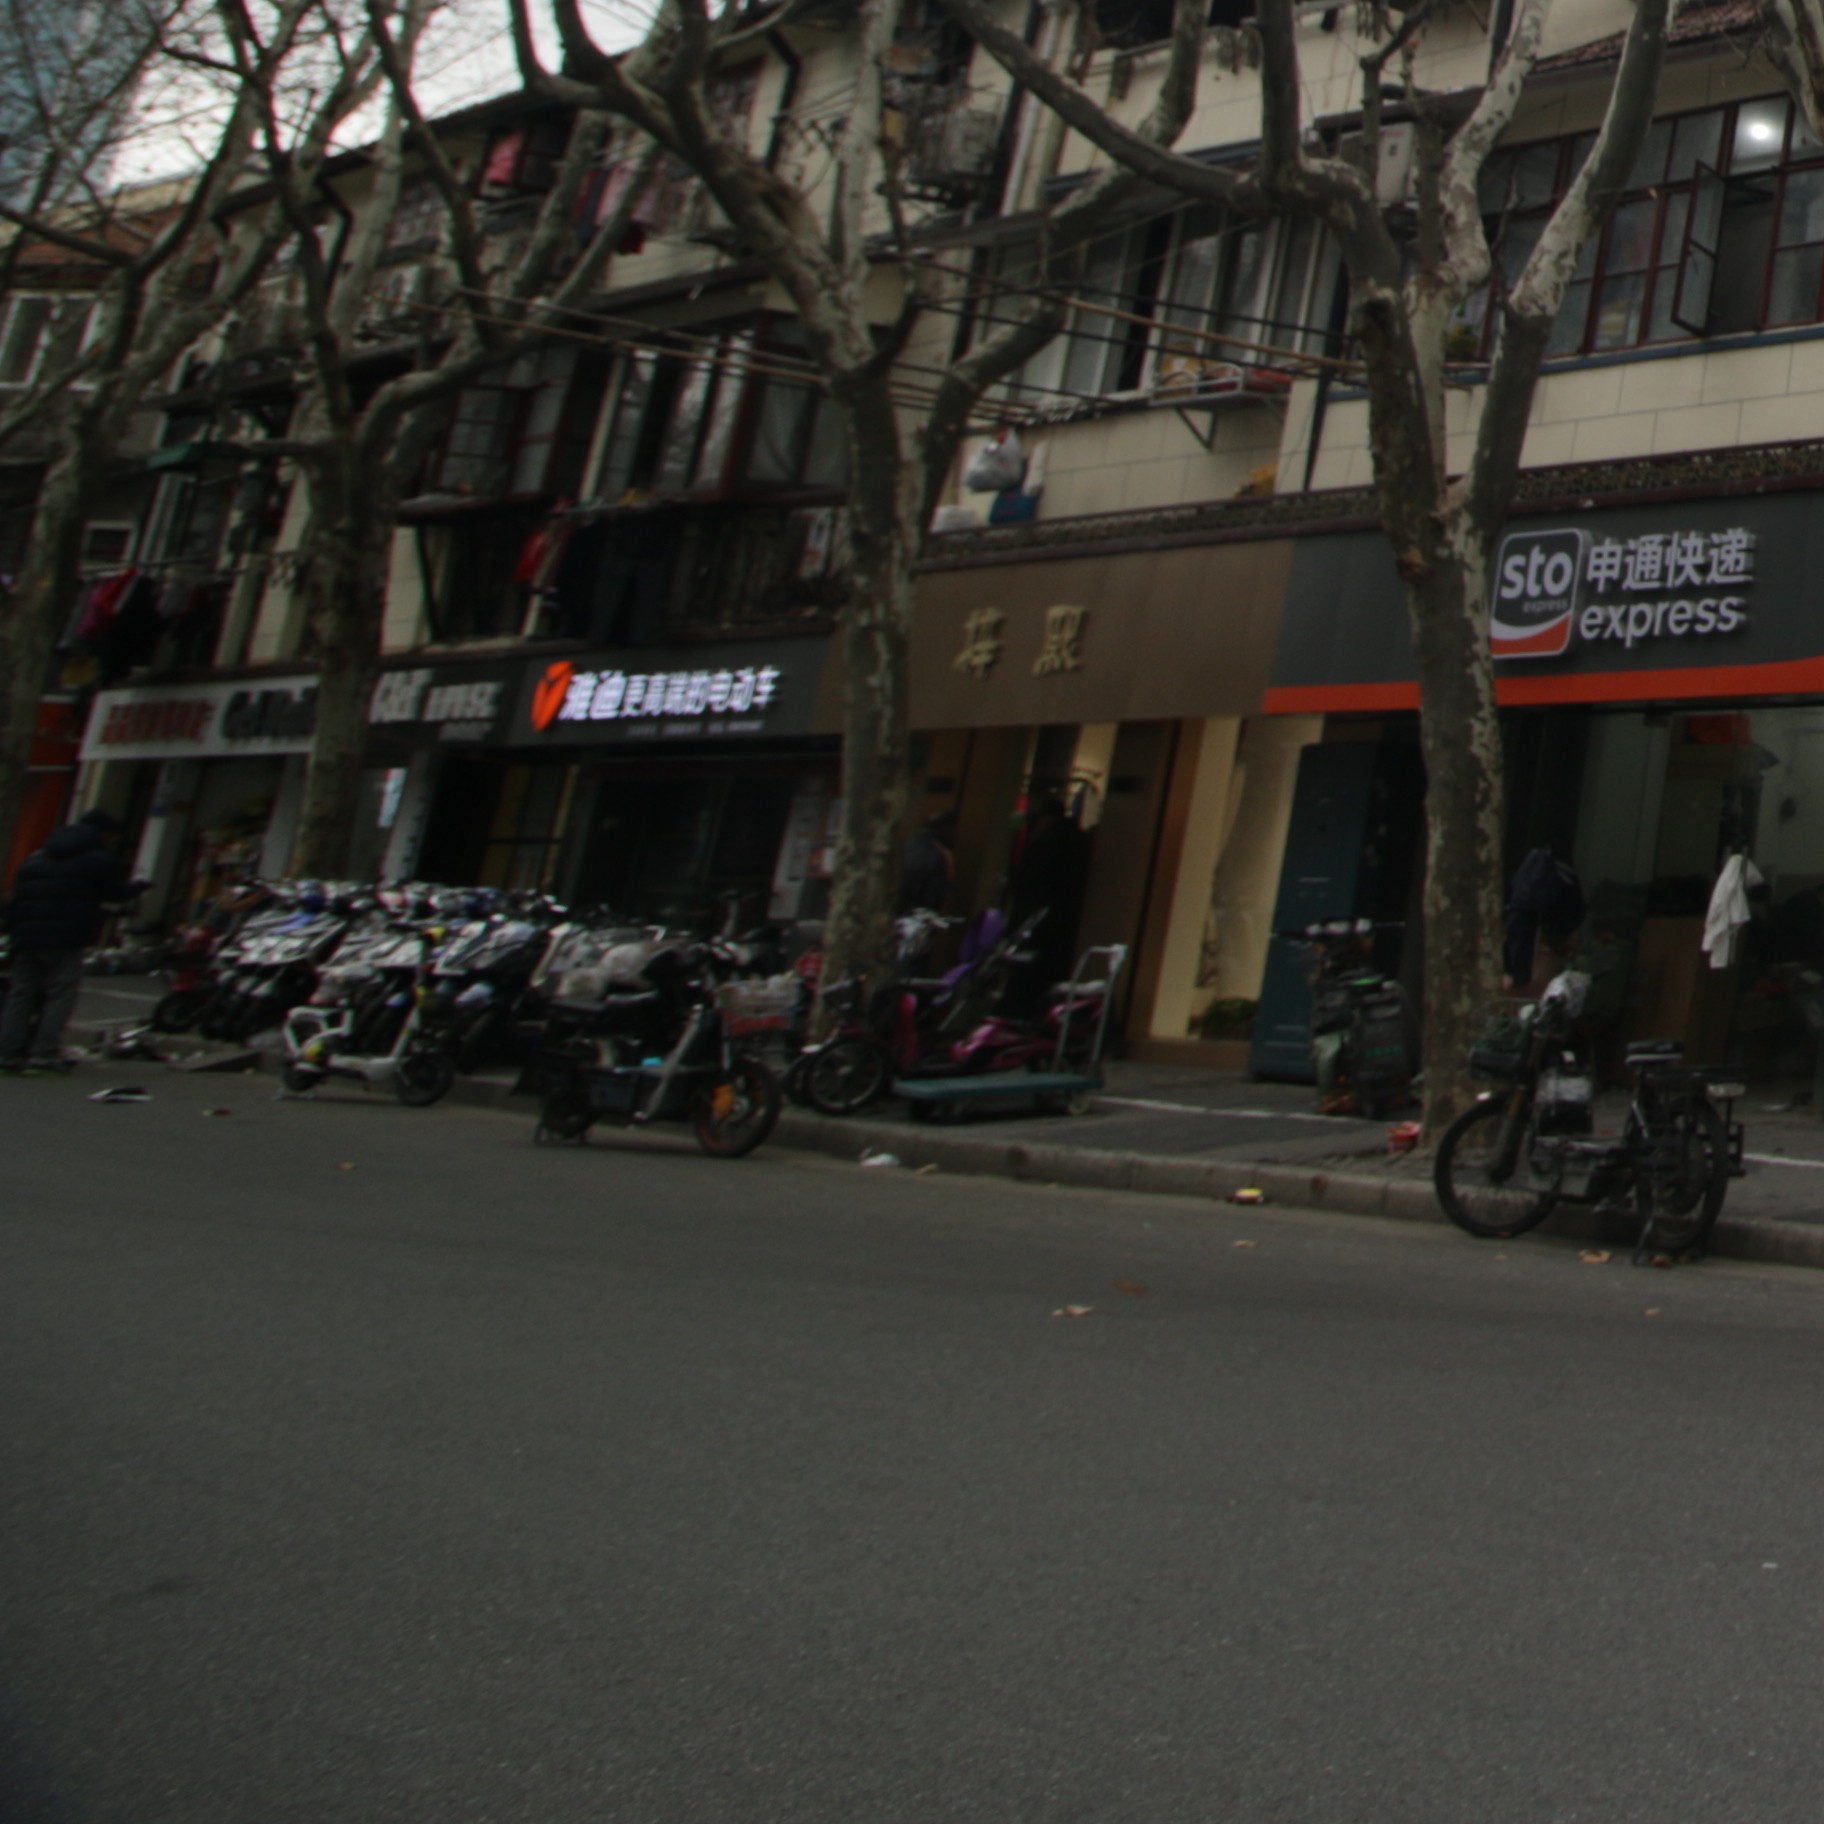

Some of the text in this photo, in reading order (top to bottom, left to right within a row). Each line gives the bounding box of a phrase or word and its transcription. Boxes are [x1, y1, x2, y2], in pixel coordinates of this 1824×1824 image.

[1499, 544, 1573, 600] sto
[1586, 526, 1755, 594] 申通快递
[1521, 596, 1569, 616] express
[1579, 595, 1743, 649] express
